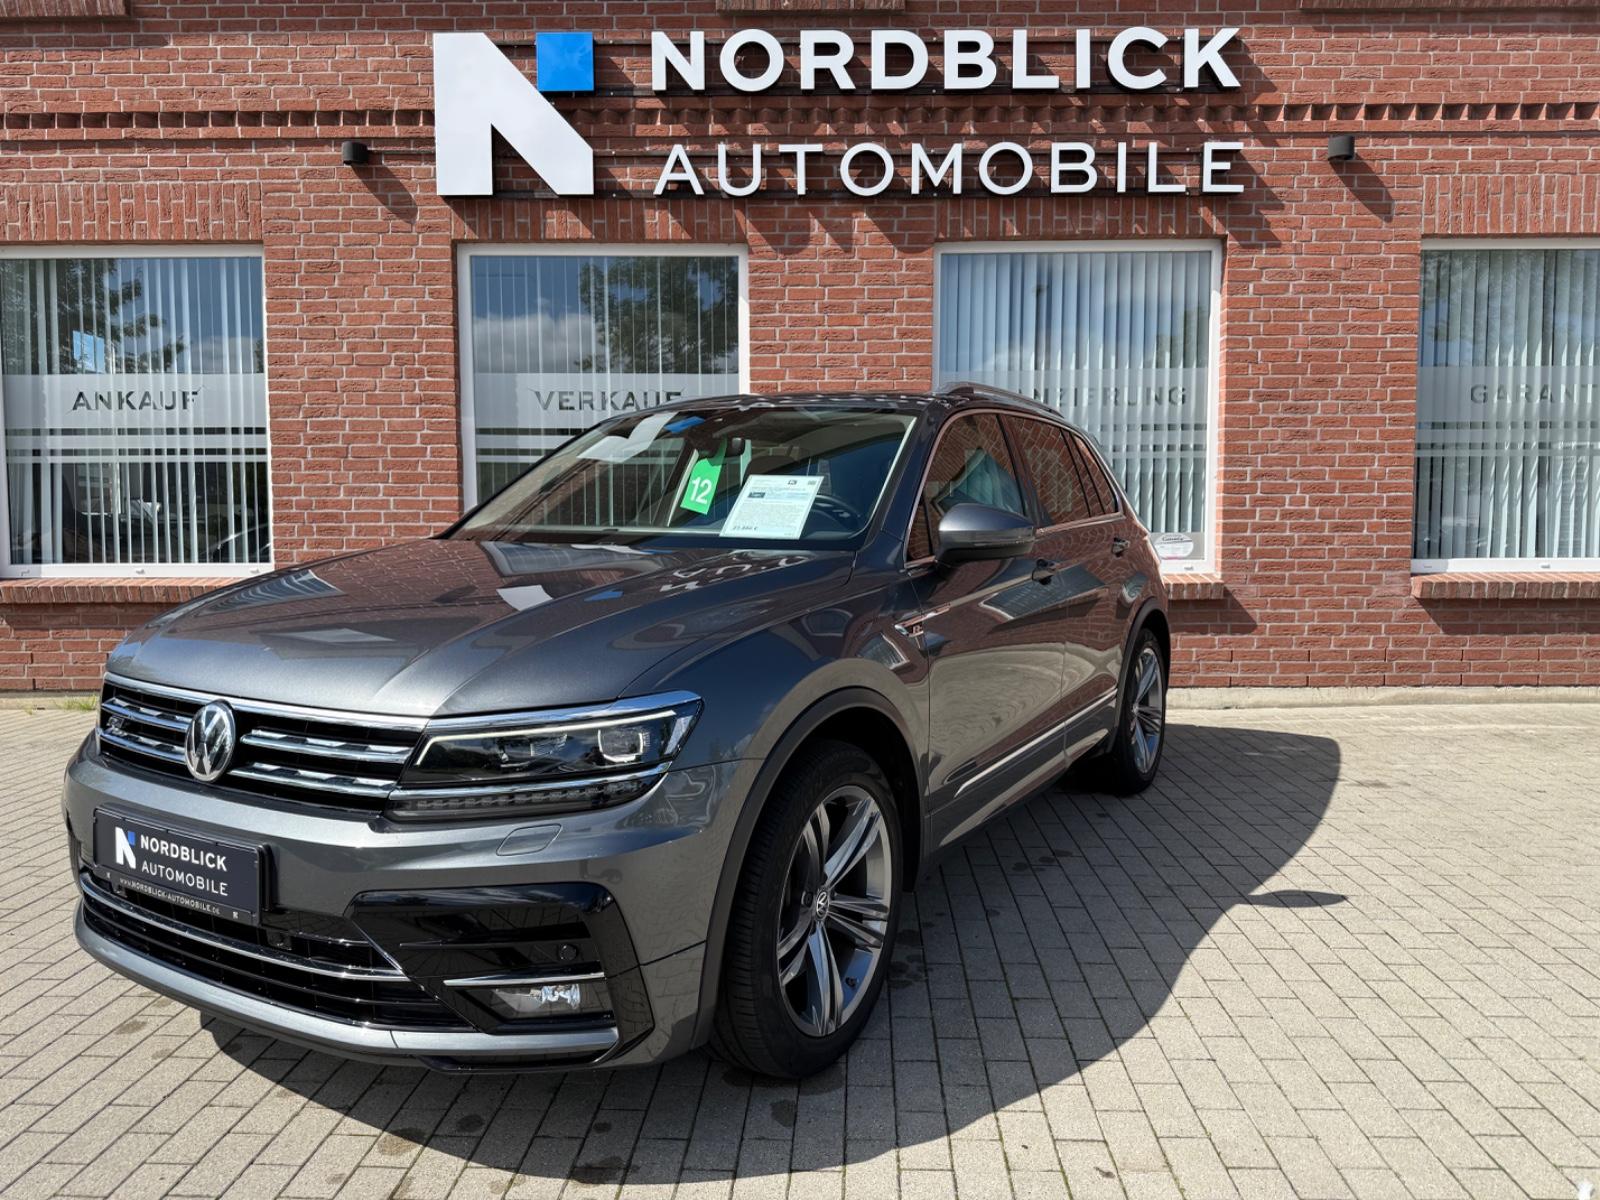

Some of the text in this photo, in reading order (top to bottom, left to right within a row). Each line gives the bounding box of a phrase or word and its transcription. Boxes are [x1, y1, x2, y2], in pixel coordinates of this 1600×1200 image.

[651, 26, 1241, 92] NORDBLICK
[653, 141, 1244, 196] AUTOMOBILE
[72, 390, 198, 411] ANKAUF
[1470, 383, 1599, 403] GARANT
[691, 476, 712, 505] 12
[140, 834, 228, 872] NORDBLICK
[141, 860, 229, 896] AUTOMOBILE
